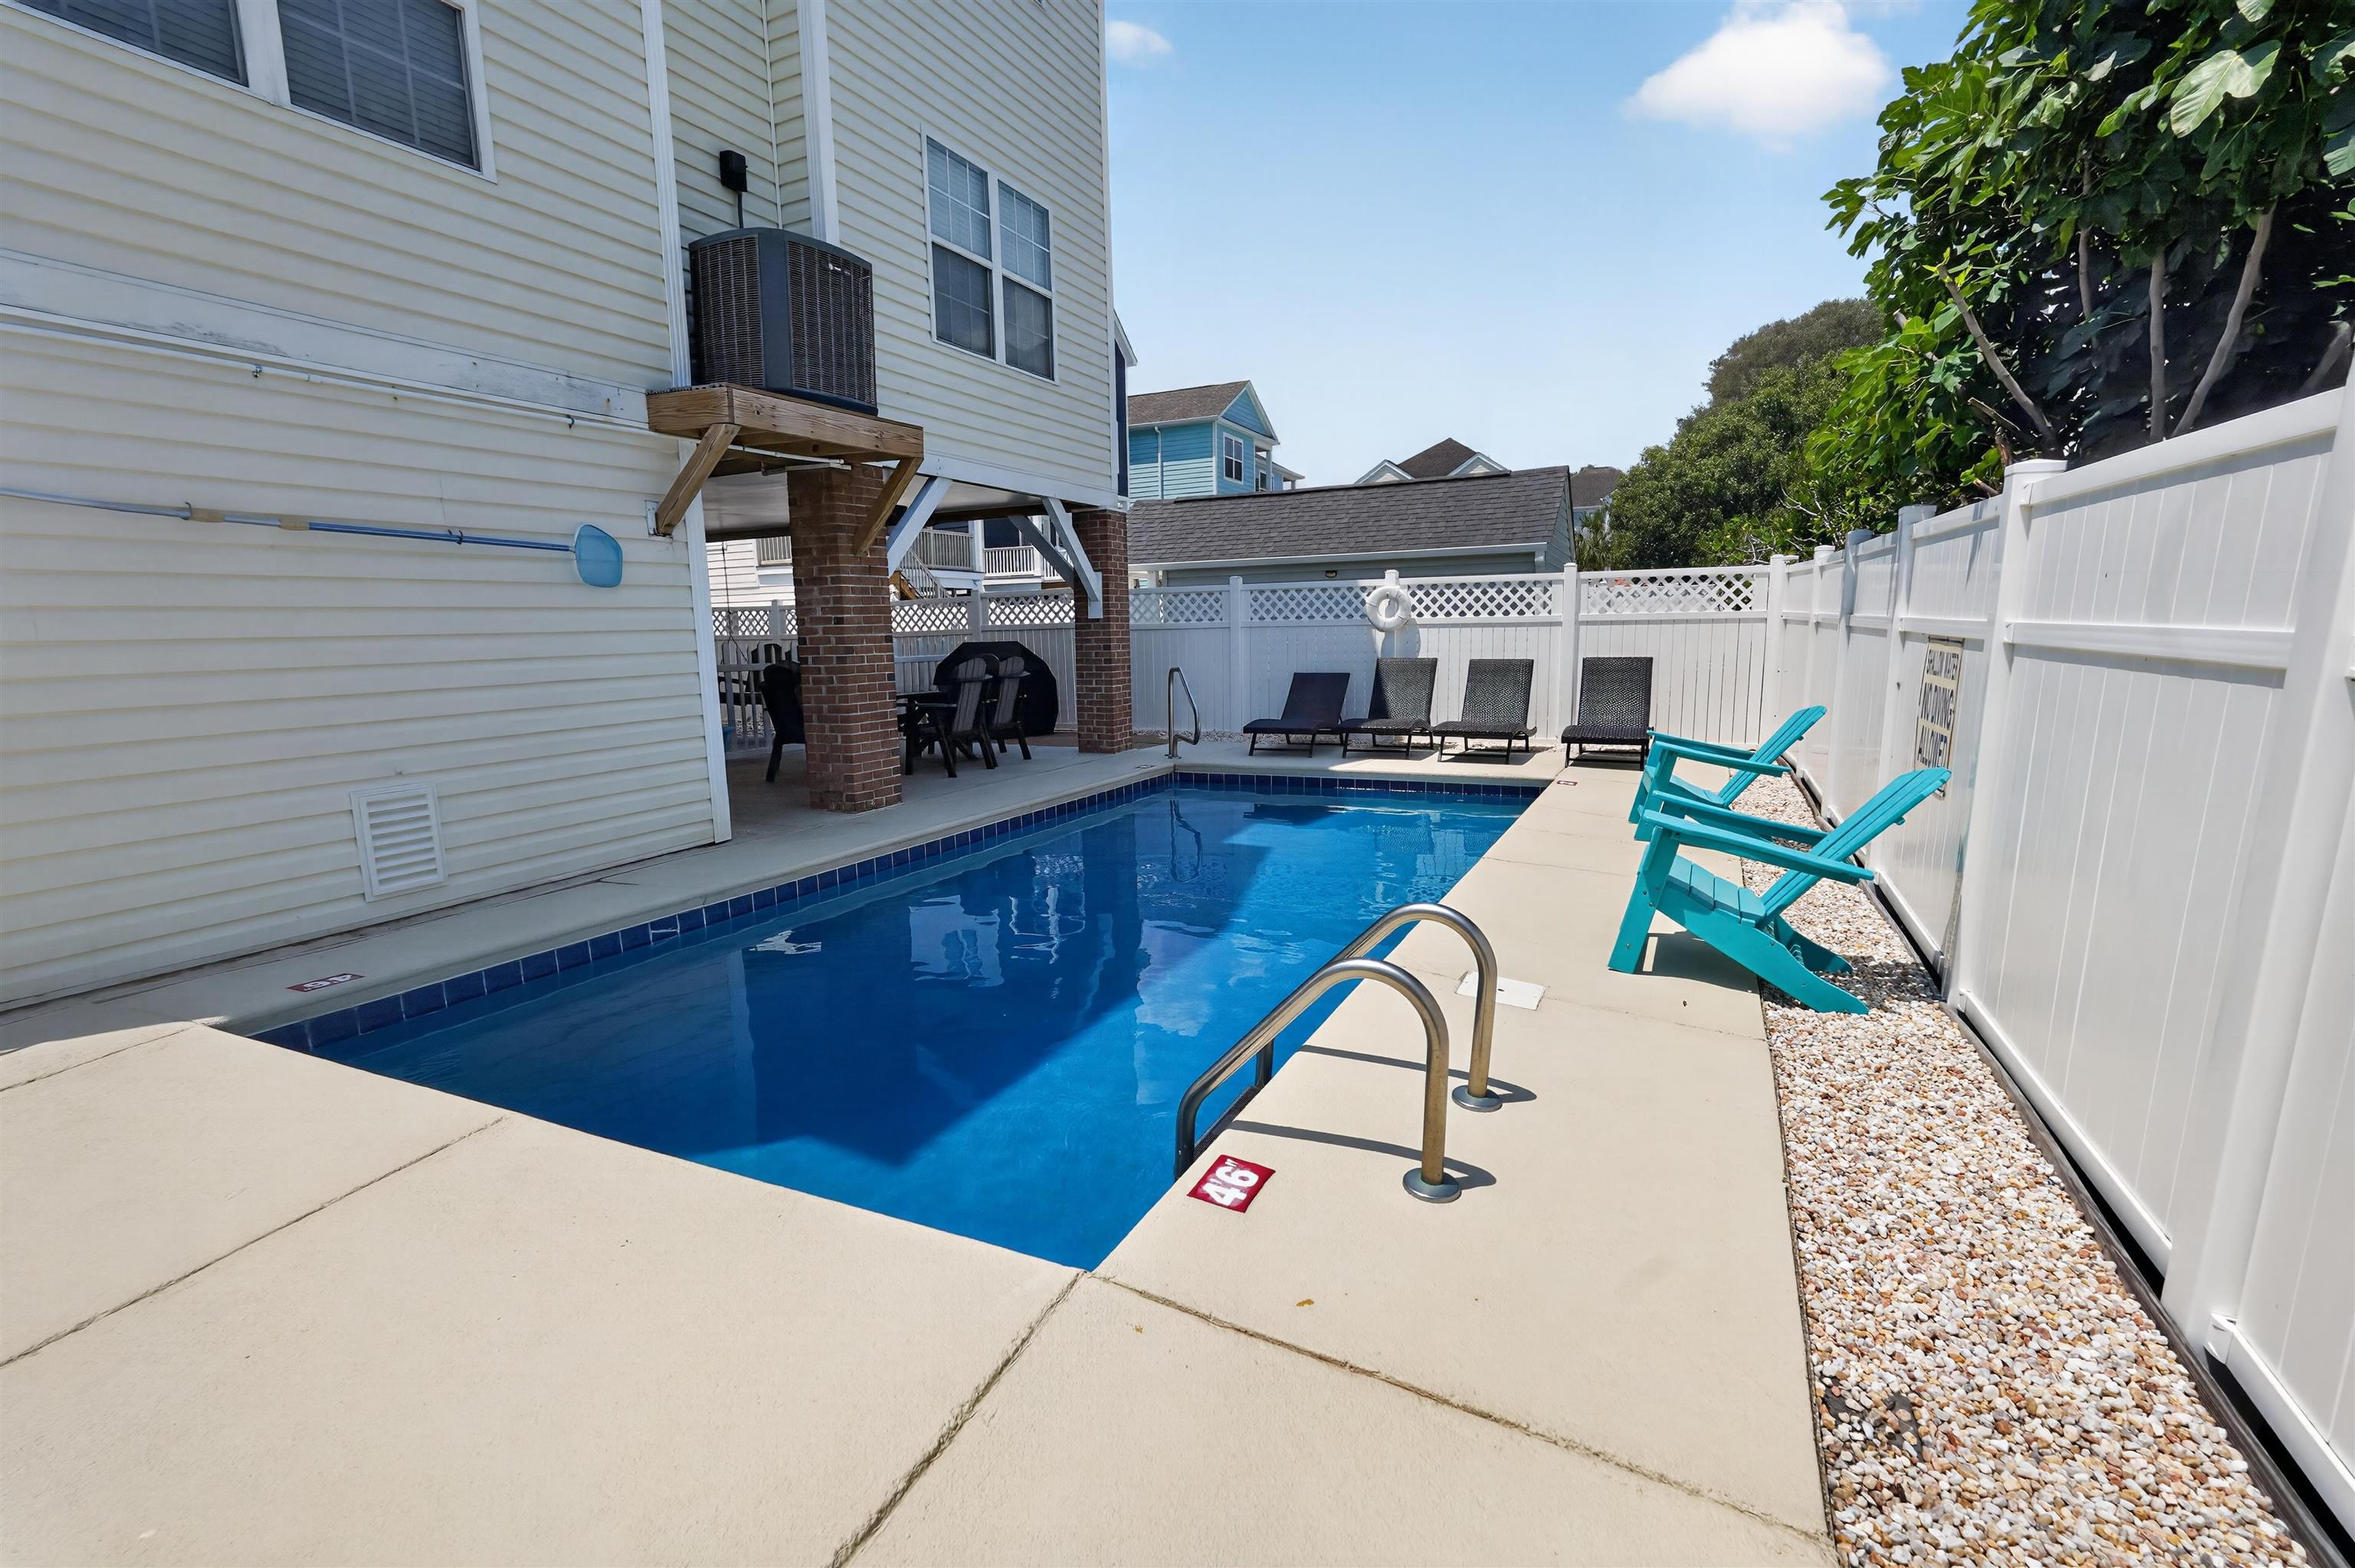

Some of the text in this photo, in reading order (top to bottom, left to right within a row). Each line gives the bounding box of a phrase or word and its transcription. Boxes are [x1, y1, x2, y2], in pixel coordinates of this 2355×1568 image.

[1921, 682, 1954, 730] NO DIVING
[1917, 724, 1948, 768] ALLOWED
[1202, 1158, 1260, 1206] 4'6"
